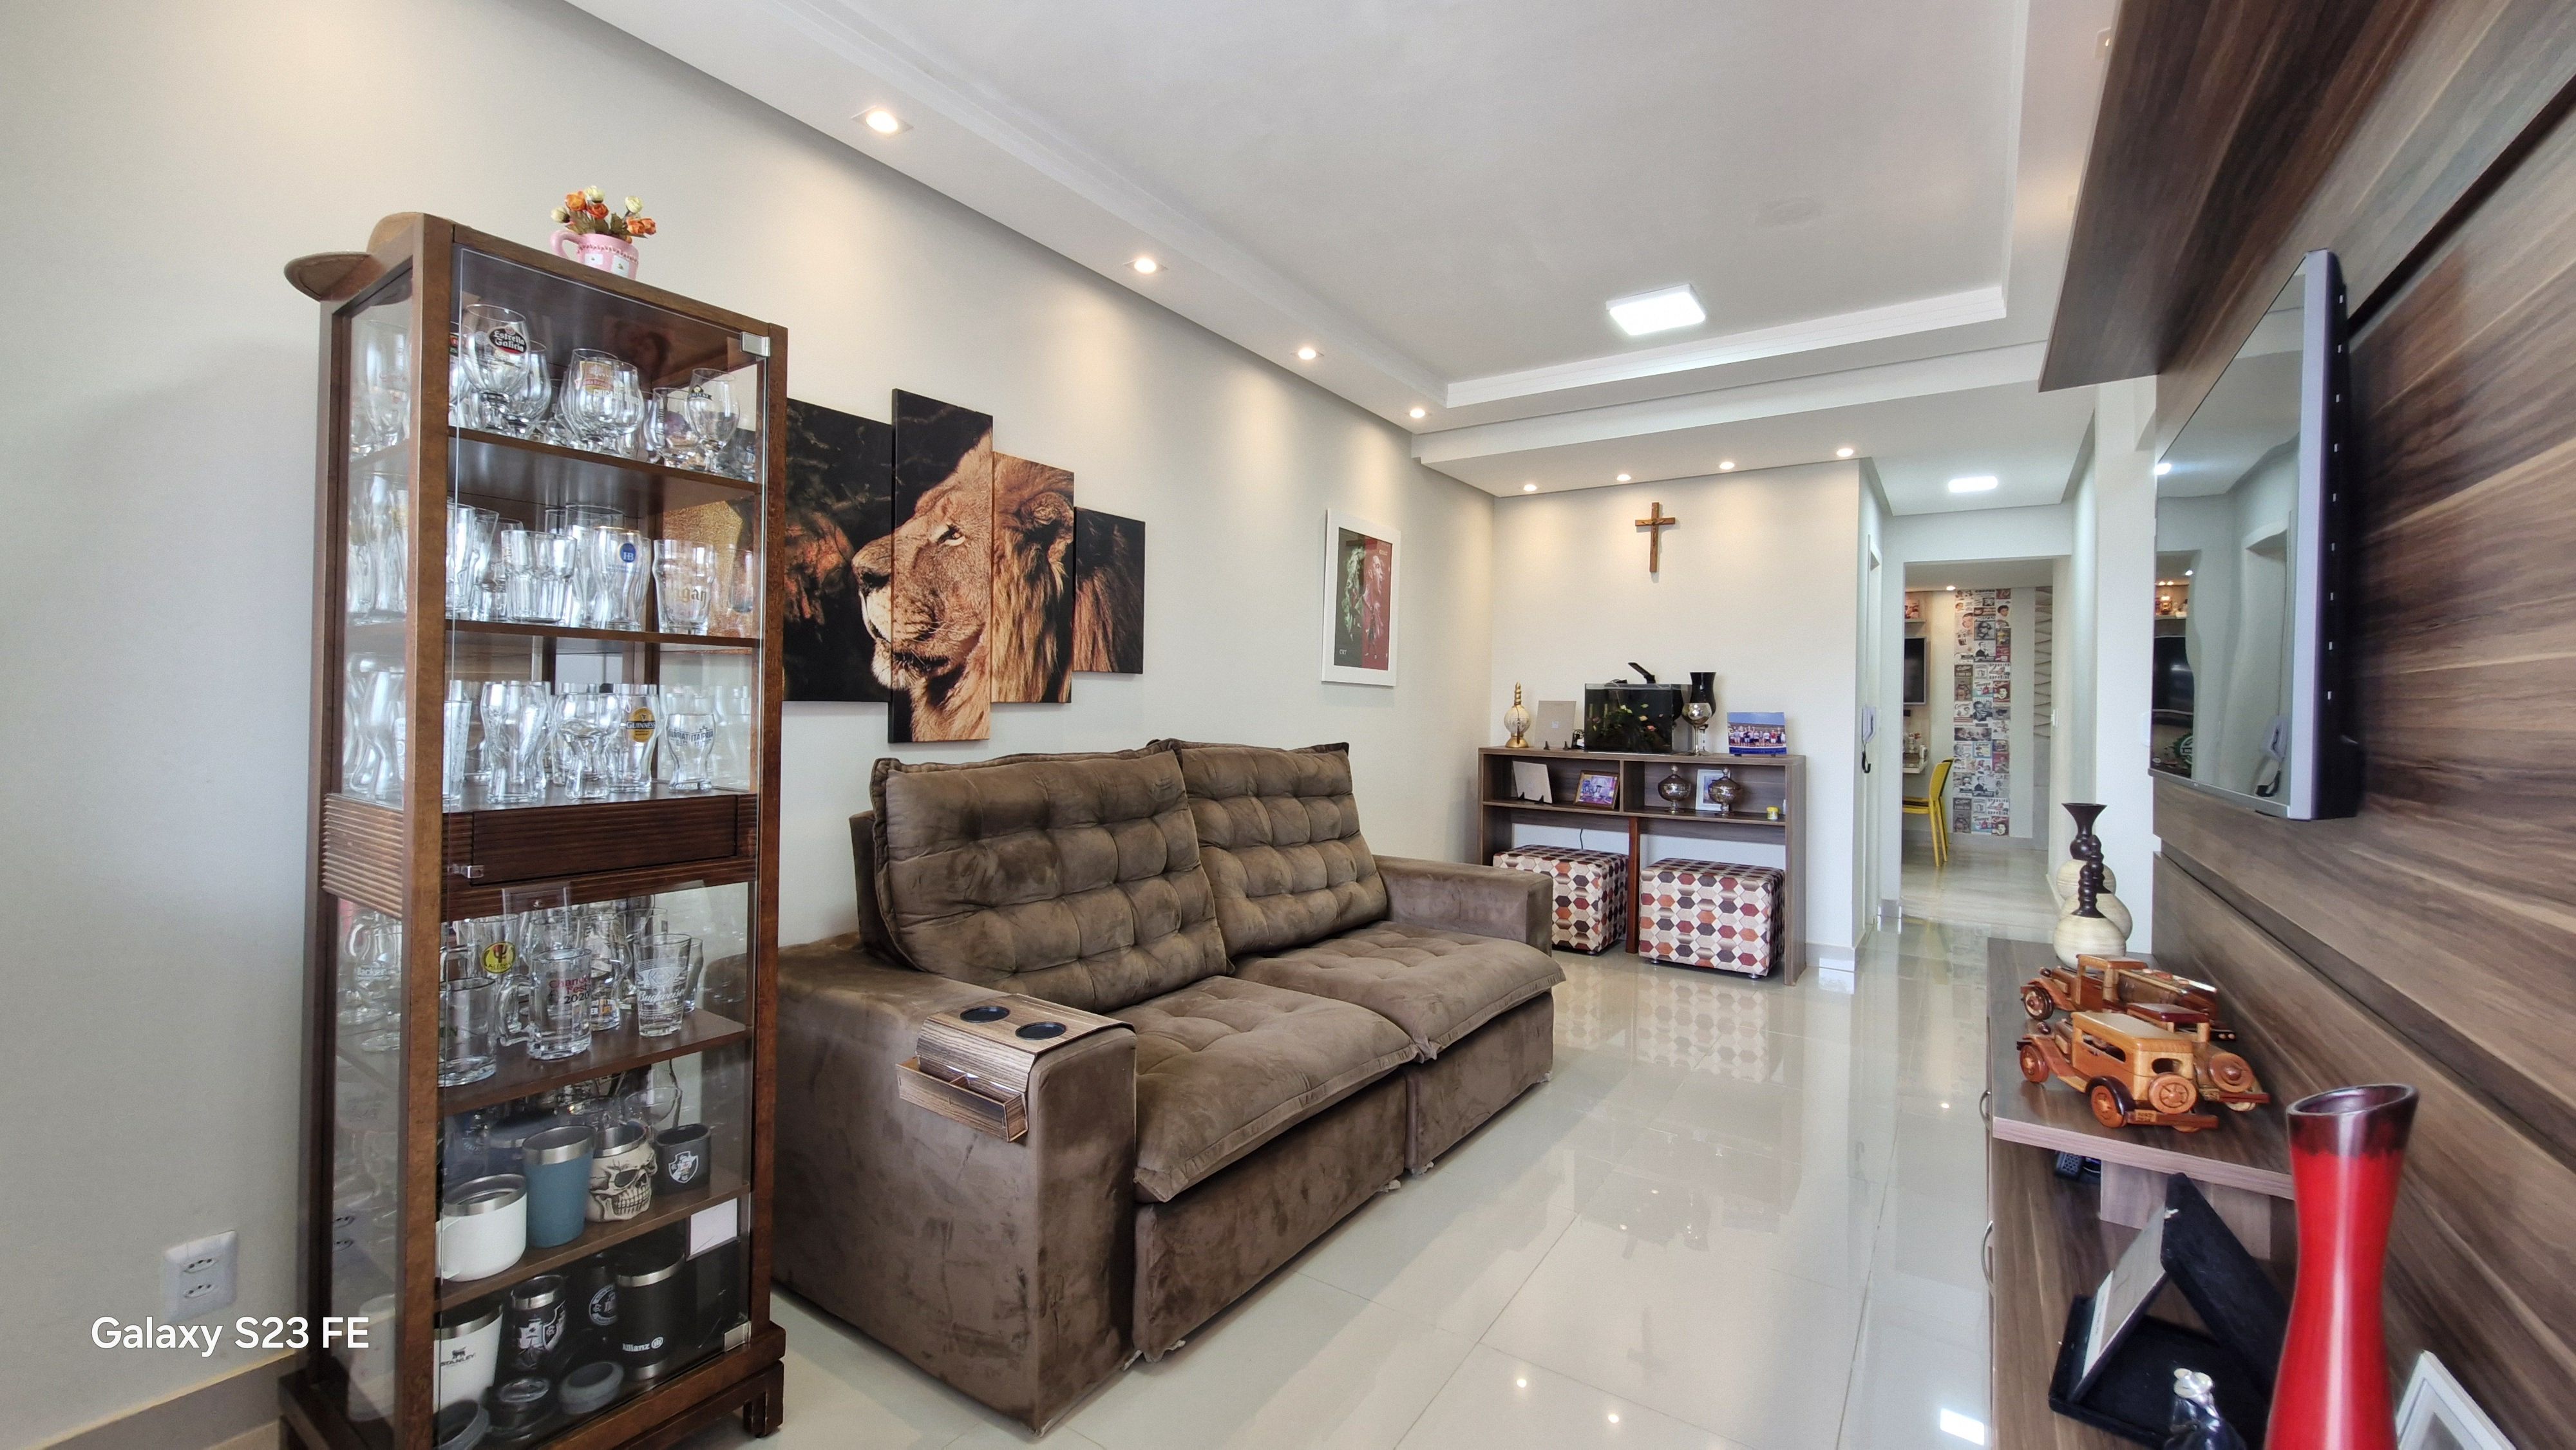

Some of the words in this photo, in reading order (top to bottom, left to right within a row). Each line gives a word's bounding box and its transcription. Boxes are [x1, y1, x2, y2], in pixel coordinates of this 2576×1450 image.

[493, 330, 525, 345] Estrella
[495, 338, 524, 352] Galicia
[567, 984, 587, 994] Fest
